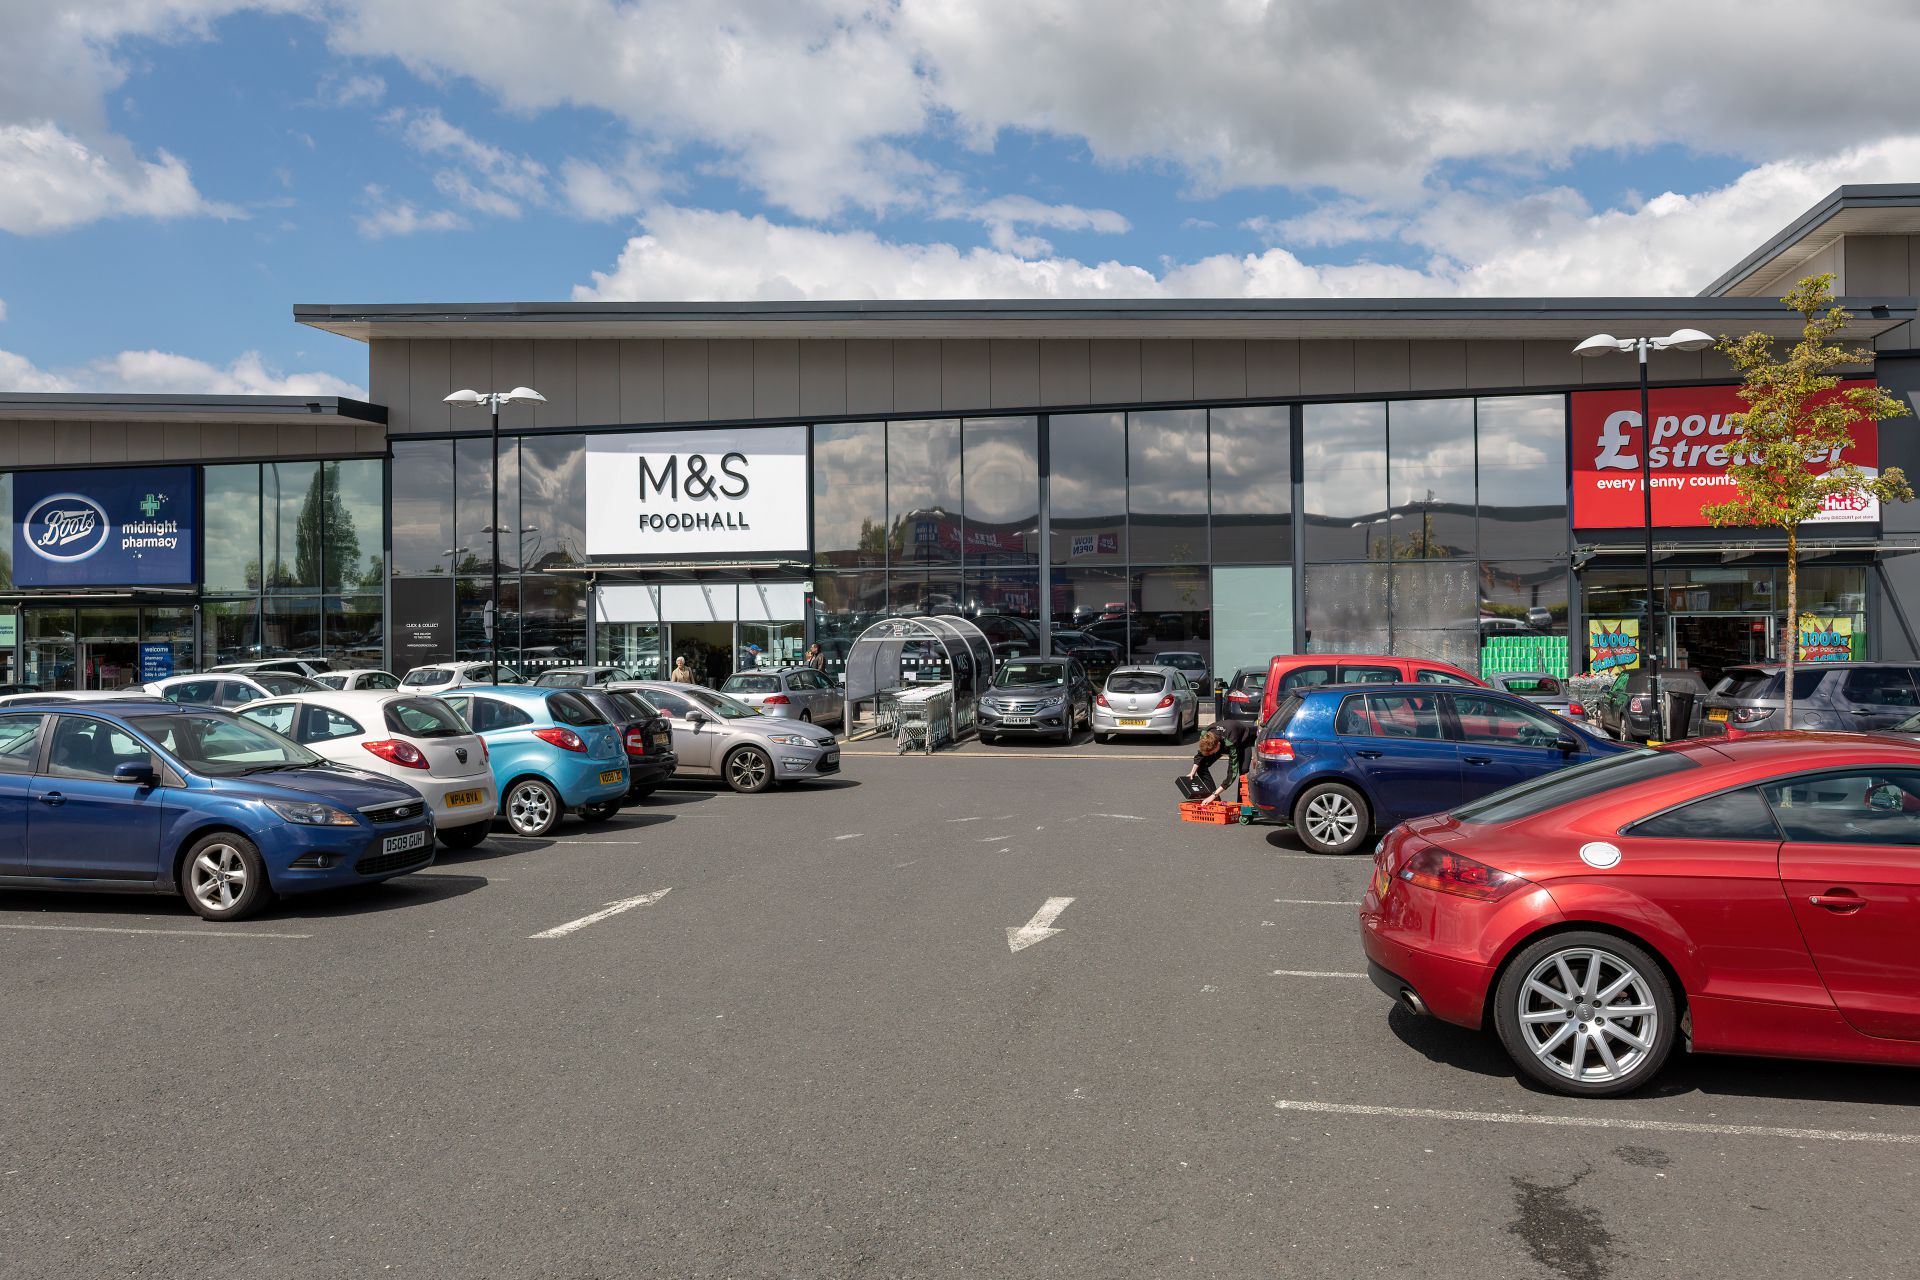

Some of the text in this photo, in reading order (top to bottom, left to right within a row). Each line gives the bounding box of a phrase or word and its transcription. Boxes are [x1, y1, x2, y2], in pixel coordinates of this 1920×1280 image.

[639, 452, 749, 500] M&S
[1596, 478, 1636, 491] every
[1824, 494, 1853, 510] Hut
[37, 509, 95, 546] Boots
[122, 520, 178, 536] midnight
[639, 512, 749, 530] FOODHALL
[122, 535, 178, 550] pharmacy
[1592, 632, 1636, 648] 1000s
[1802, 631, 1848, 647] 1000s
[386, 833, 423, 853] DS09 GUH
